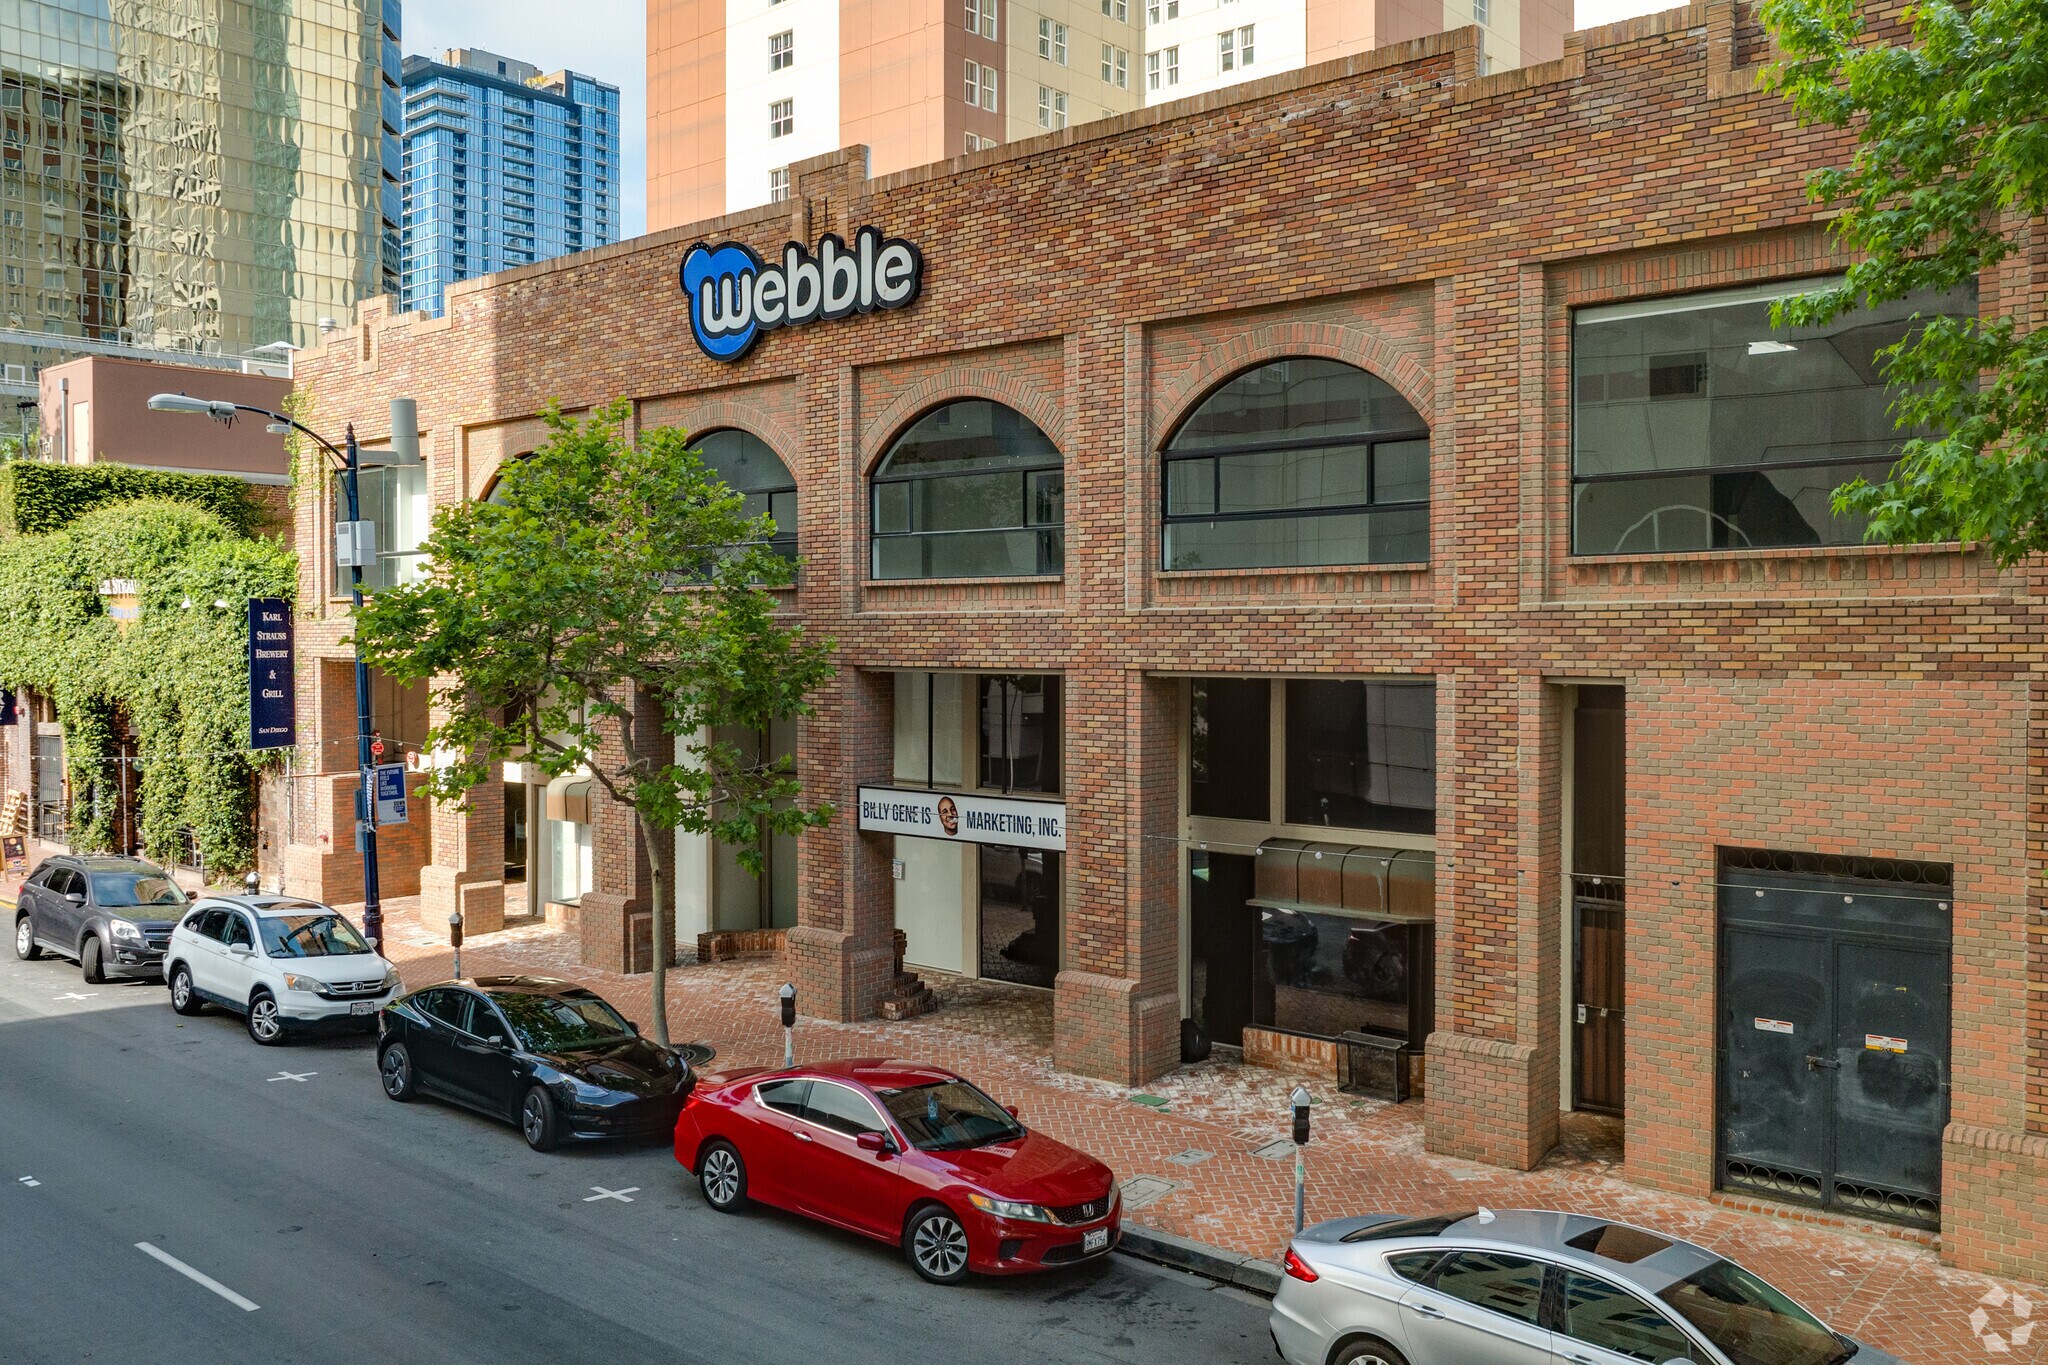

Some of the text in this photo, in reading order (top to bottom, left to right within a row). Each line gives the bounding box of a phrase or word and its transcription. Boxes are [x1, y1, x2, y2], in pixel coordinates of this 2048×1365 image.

[702, 231, 913, 333] webble
[262, 611, 283, 622] KARL
[256, 630, 287, 641] STRAUSS
[255, 648, 289, 659] BREWERY
[269, 669, 277, 680] &
[262, 688, 284, 699] GRILL
[270, 726, 289, 734] DIEGO
[863, 801, 1061, 838] BILLY GENE IS MARKETING, INC.
